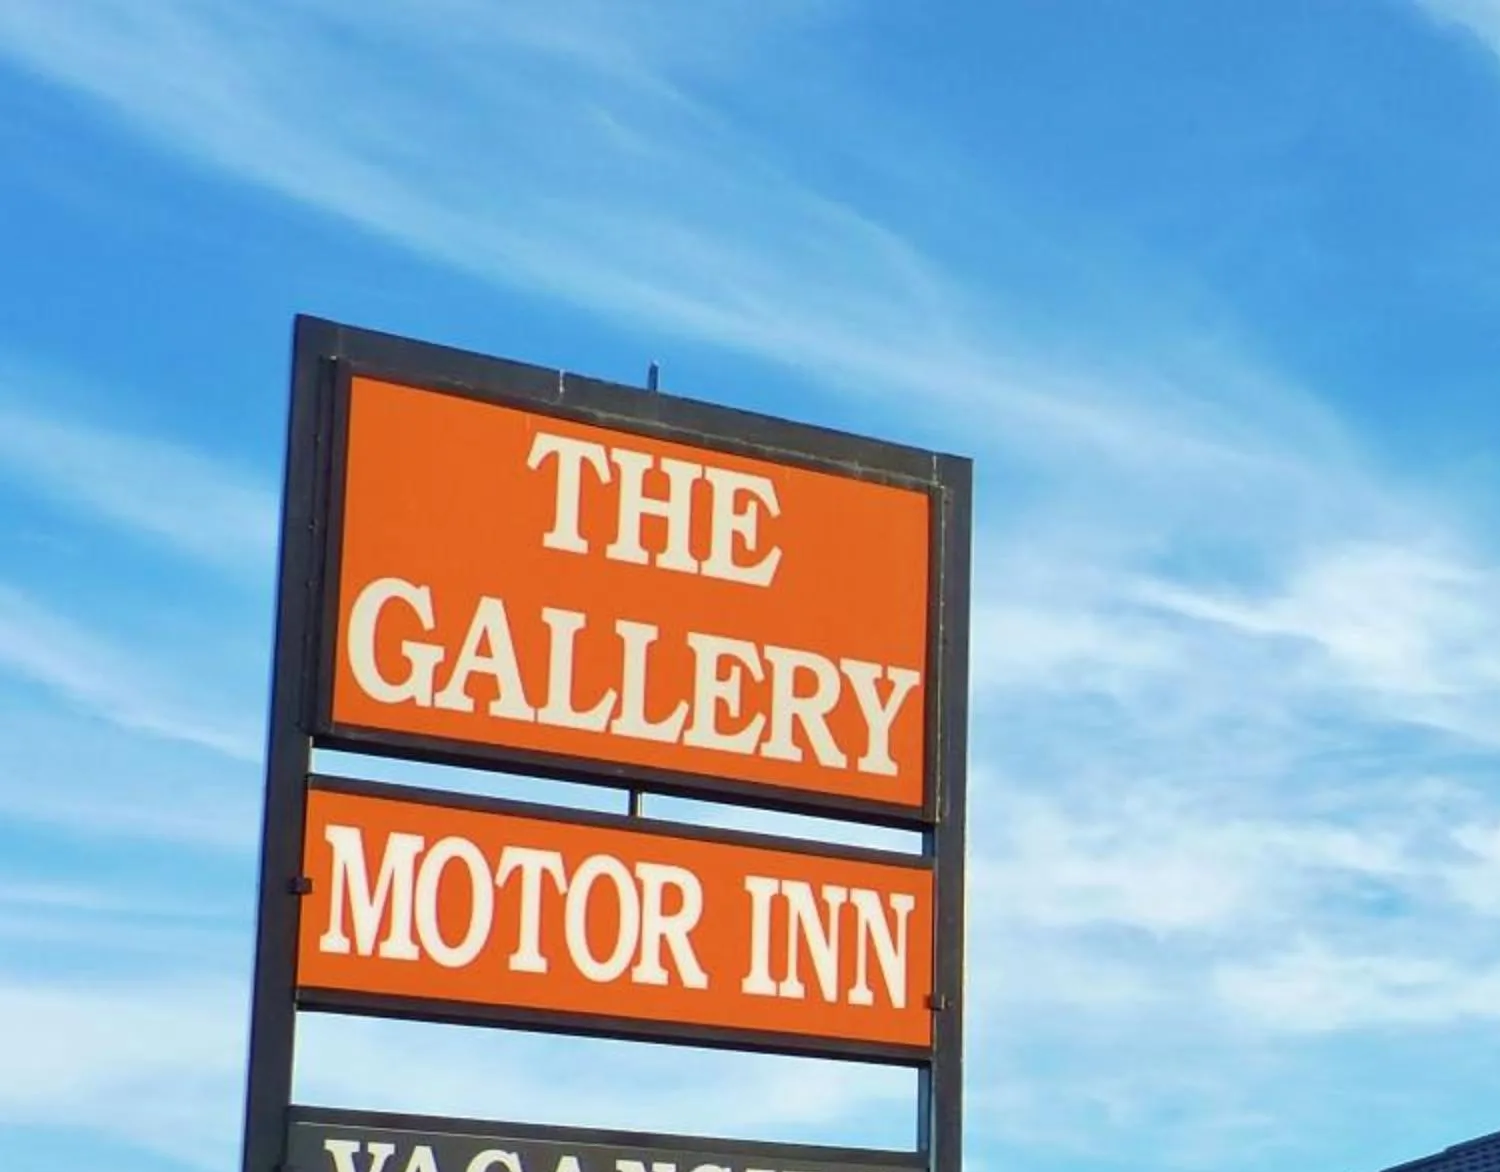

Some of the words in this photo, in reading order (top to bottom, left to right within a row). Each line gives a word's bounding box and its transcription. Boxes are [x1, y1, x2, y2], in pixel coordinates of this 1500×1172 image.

[527, 432, 781, 587] THE
[348, 577, 921, 776] GALLERY
[319, 825, 708, 990] MOTOR
[742, 876, 915, 1009] INN
